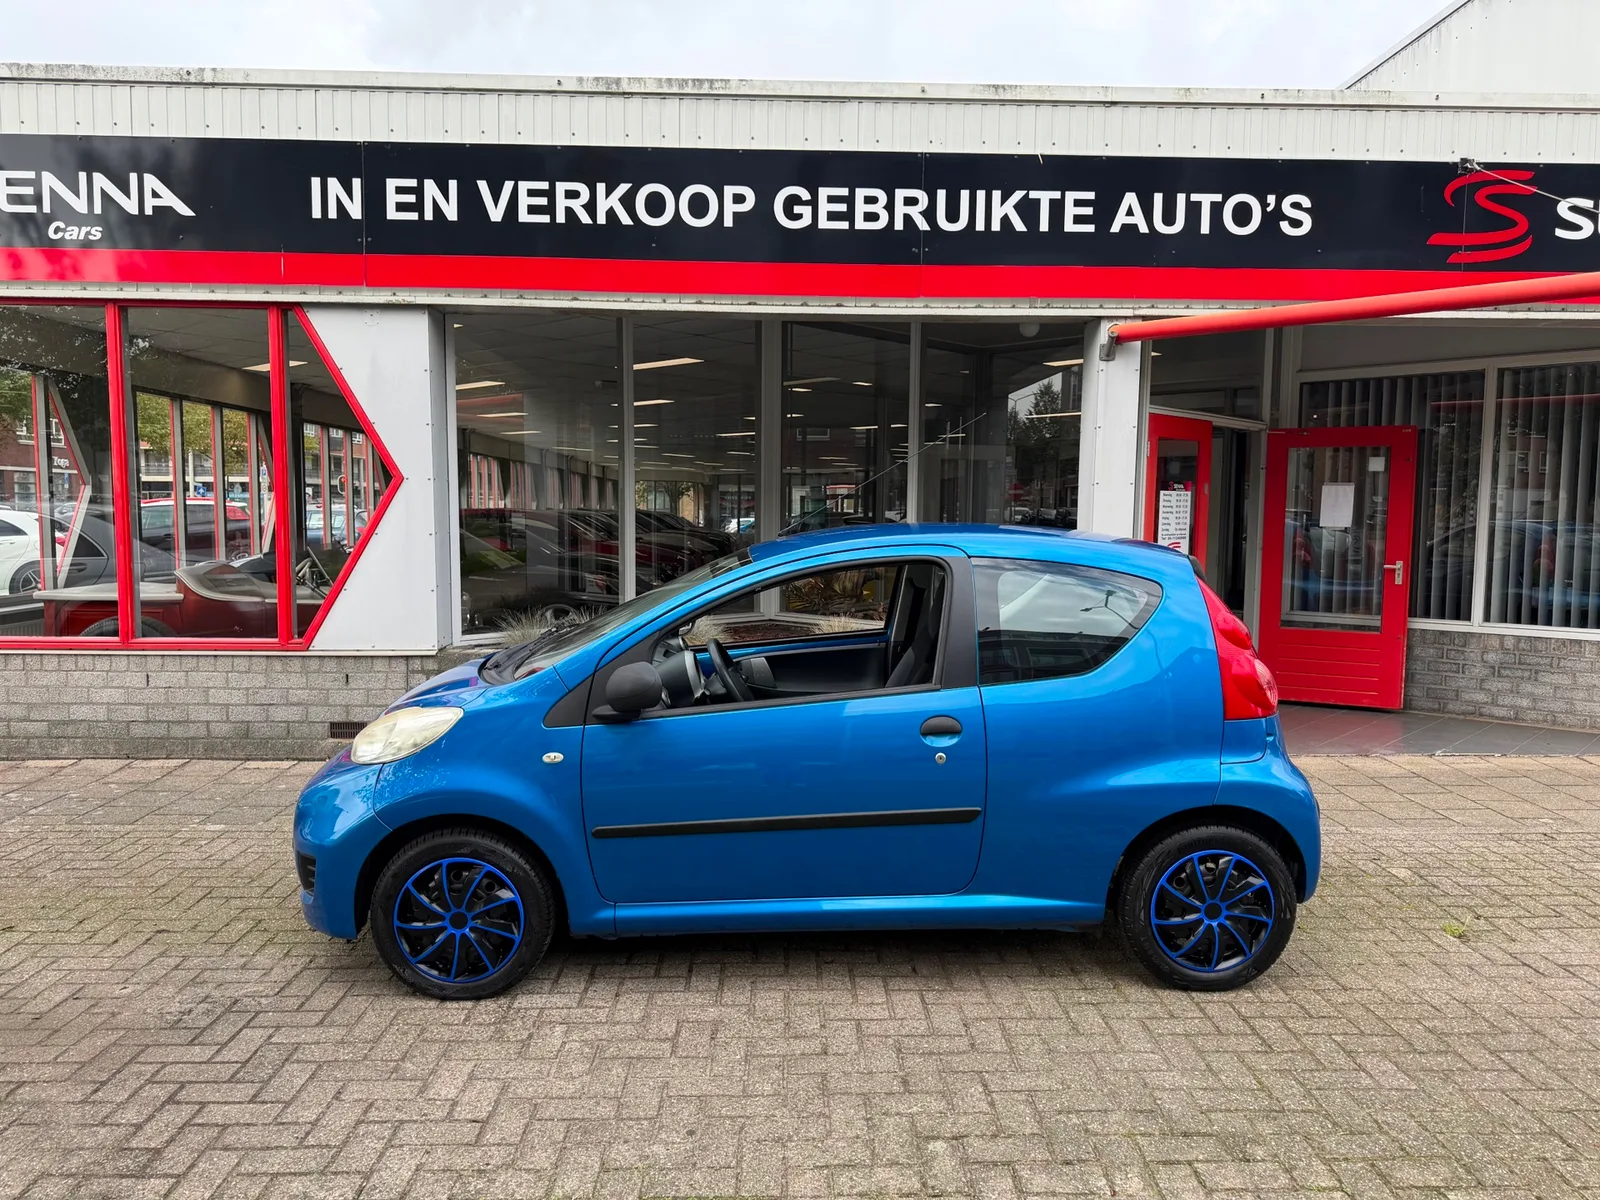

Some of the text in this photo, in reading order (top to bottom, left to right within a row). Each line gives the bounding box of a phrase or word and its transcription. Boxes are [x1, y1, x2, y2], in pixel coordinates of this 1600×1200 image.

[310, 176, 362, 220] IN
[386, 177, 458, 222] EN
[477, 179, 756, 228] VERKOOP
[773, 185, 1096, 233] GEBRUIKTE
[1554, 197, 1600, 240] S
[47, 220, 103, 240] Cars
